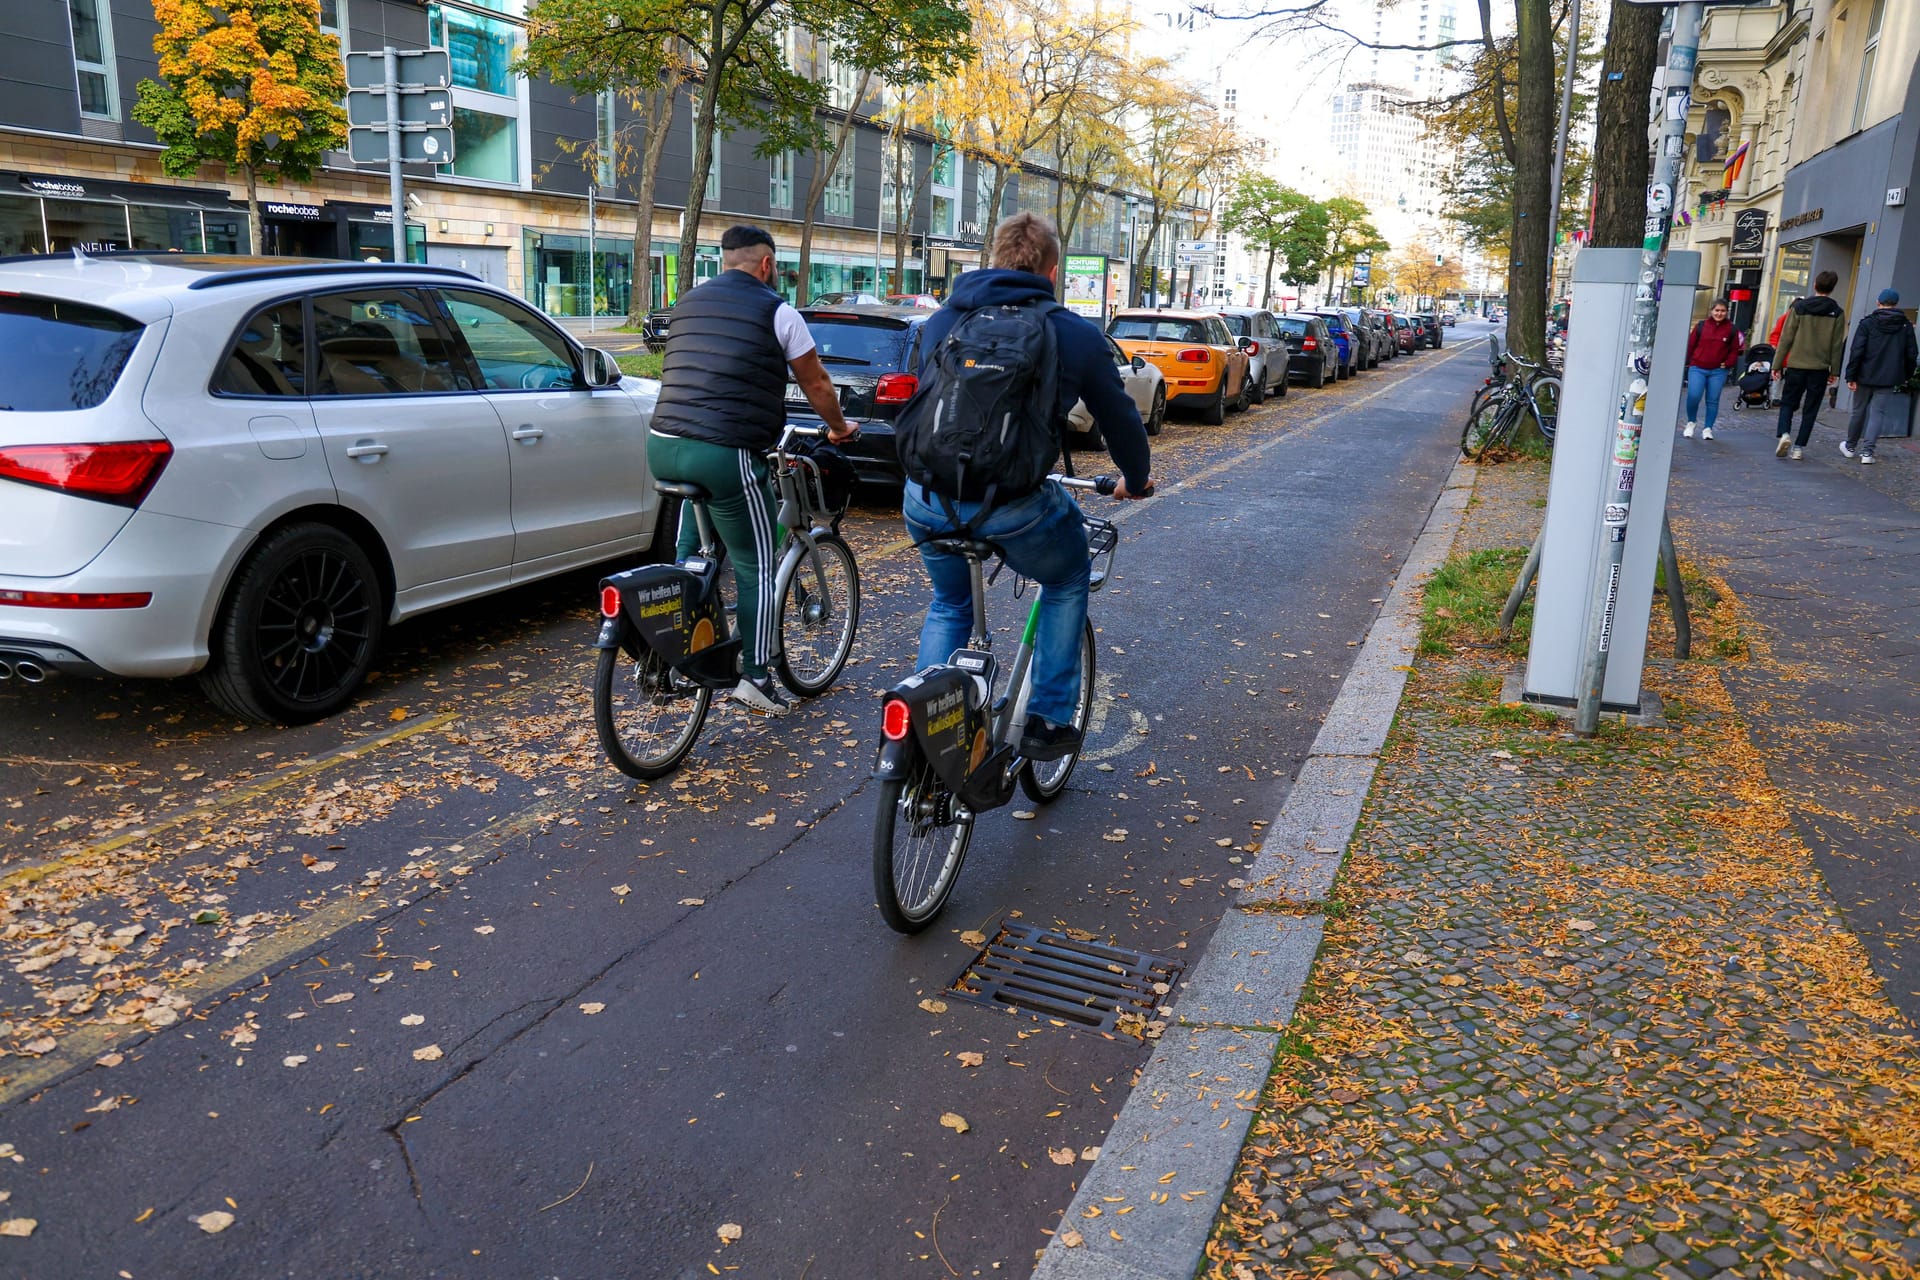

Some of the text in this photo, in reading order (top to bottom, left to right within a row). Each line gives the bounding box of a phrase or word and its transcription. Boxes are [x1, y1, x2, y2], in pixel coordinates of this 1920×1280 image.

[1888, 191, 1899, 201] 147
[268, 204, 319, 216] rochebobois
[959, 220, 982, 236] LIVING
[638, 588, 651, 603] Wir
[651, 584, 671, 600] helfen
[1601, 564, 1620, 651] schnellejugend
[926, 702, 938, 717] Wir
[938, 692, 956, 712] helfen
